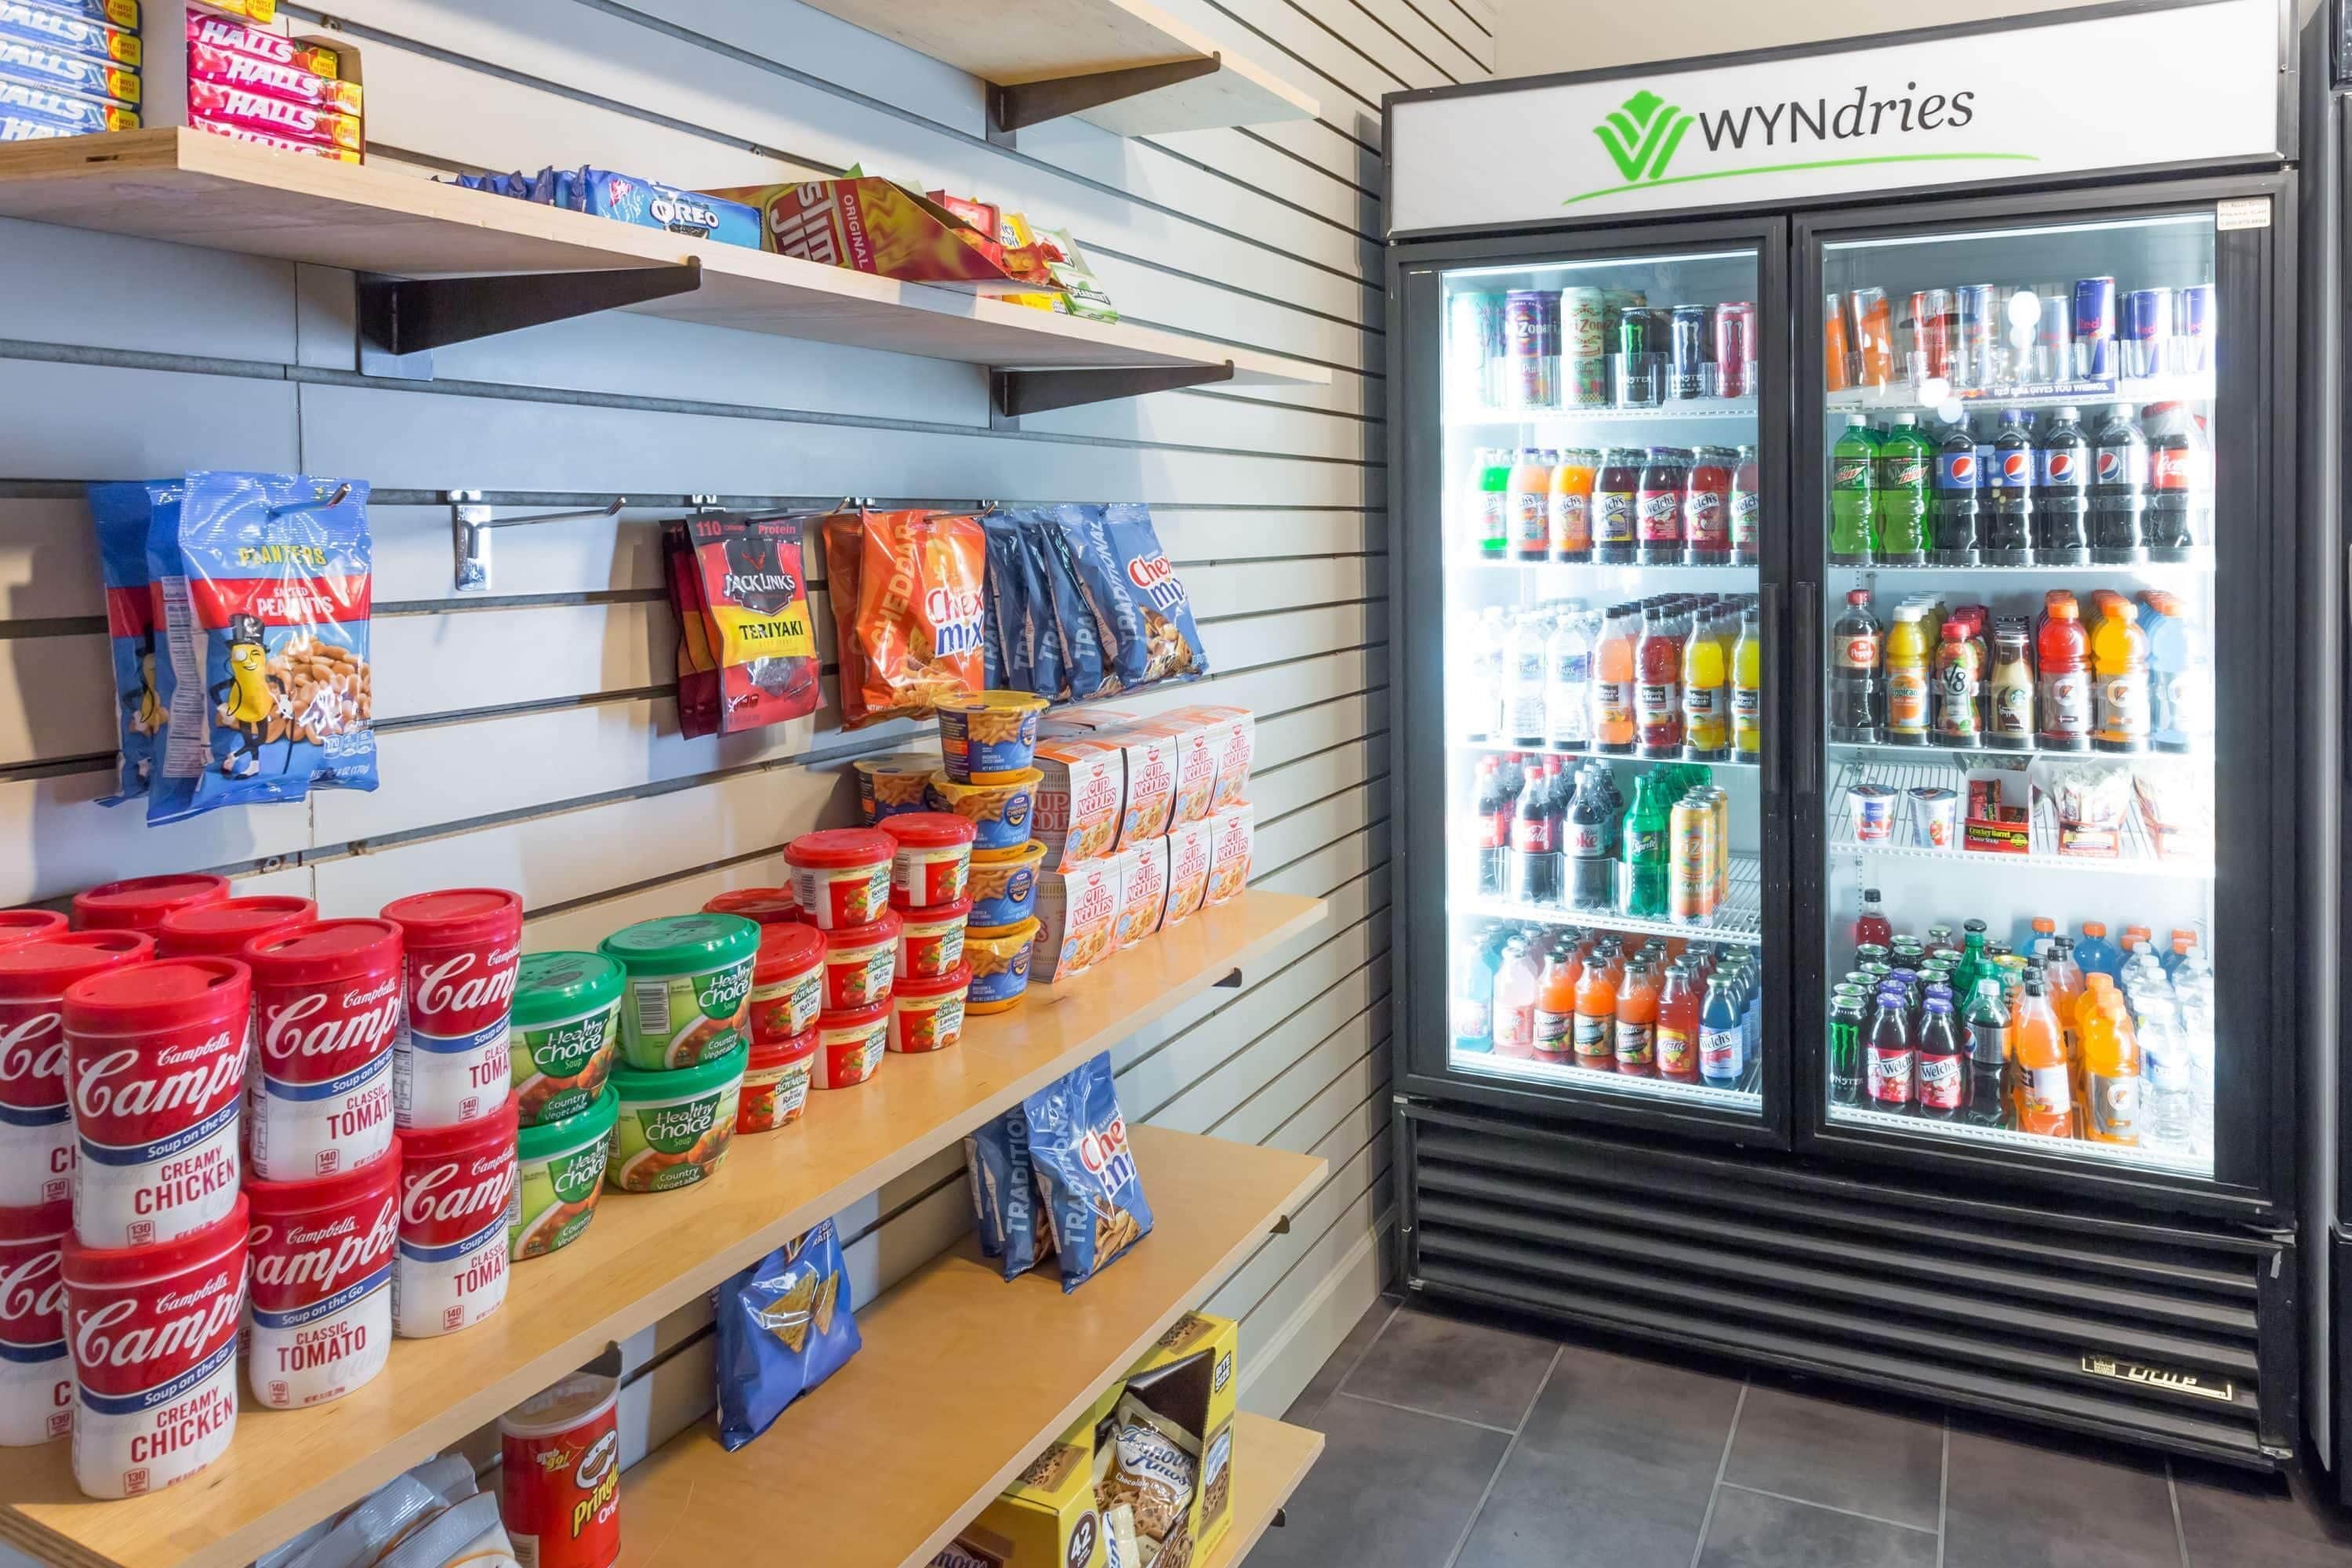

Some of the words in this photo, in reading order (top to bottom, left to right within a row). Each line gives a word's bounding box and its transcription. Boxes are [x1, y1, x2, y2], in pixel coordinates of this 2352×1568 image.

[0, 2, 89, 42] ALLS
[199, 20, 295, 64] HALLS
[0, 41, 87, 80] ALLS
[226, 54, 321, 96] HALLS
[0, 82, 86, 120] ALLS
[223, 89, 318, 131] HALLS
[1698, 80, 1976, 154] WYNdries
[650, 198, 720, 229] OREO
[797, 181, 838, 267] SLIM
[843, 194, 872, 269] ORIGINAL
[695, 521, 723, 537] 110
[758, 523, 797, 535] Protein
[724, 573, 760, 597] JACK
[760, 572, 797, 592] LINK'S
[869, 524, 918, 650] CHEDDAR
[1090, 520, 1142, 642] TRADITIONAL
[927, 585, 984, 626] Chex
[739, 620, 804, 641] TERIYAKI
[937, 615, 984, 656] mix
[1944, 663, 1966, 692] V8
[1144, 761, 1163, 780] CUP
[1035, 792, 1069, 812] UP
[1087, 777, 1109, 796] CUP
[1076, 787, 1116, 818] NOODLES
[1135, 863, 1156, 884] CUP
[1083, 884, 1107, 906] CUP
[1072, 895, 1113, 928] NOODLES
[699, 977, 750, 1009] Choice
[710, 964, 754, 992] Healthy
[474, 1029, 495, 1046] Soup
[546, 1016, 608, 1047] Healthy
[708, 1031, 739, 1051] Country
[156, 1031, 233, 1067] Campbell's
[533, 1033, 602, 1067] Choice
[332, 1074, 361, 1094] Soup
[361, 1067, 374, 1081] on
[373, 1058, 387, 1074] the
[346, 1082, 386, 1110] CLASSIC
[547, 1091, 588, 1111] Country
[655, 1098, 719, 1126] Healthy
[147, 1138, 182, 1160] Soup
[182, 1129, 200, 1144] on
[199, 1117, 219, 1136] the
[218, 1109, 232, 1127] Go
[644, 1115, 711, 1142] Choice
[160, 1145, 223, 1183] CREAMY
[318, 1151, 337, 1162] 140
[45, 1181, 67, 1192] 130
[134, 1153, 236, 1216] CHICKEN
[554, 1155, 607, 1193] Choice
[659, 1166, 700, 1182] Country
[129, 1221, 152, 1235] 130
[286, 1214, 358, 1245] Campbell's
[459, 1236, 484, 1254] Soup
[484, 1229, 496, 1243] on
[156, 1270, 230, 1315] Campbell's
[281, 1308, 310, 1325] Soup
[310, 1303, 327, 1317] on
[328, 1294, 347, 1312] the
[347, 1283, 364, 1302] Go
[446, 1308, 462, 1319] 140
[296, 1320, 349, 1346] CLASSIC
[277, 1325, 366, 1373] TOMATO
[143, 1386, 177, 1406] Soup
[178, 1374, 196, 1390] on
[196, 1361, 216, 1381] the
[215, 1347, 230, 1365] Go
[1216, 1352, 1231, 1378] BITE
[1216, 1366, 1231, 1392] SIZE
[271, 1383, 285, 1394] 140
[49, 1412, 71, 1425] 130
[156, 1386, 220, 1429] CREAMY
[130, 1392, 233, 1463] CHICKEN
[546, 1452, 571, 1469] go!
[1125, 1454, 1189, 1486] Amos
[126, 1470, 147, 1483] 130
[1116, 1472, 1150, 1490] Chocolate
[1071, 1521, 1091, 1560] 42
